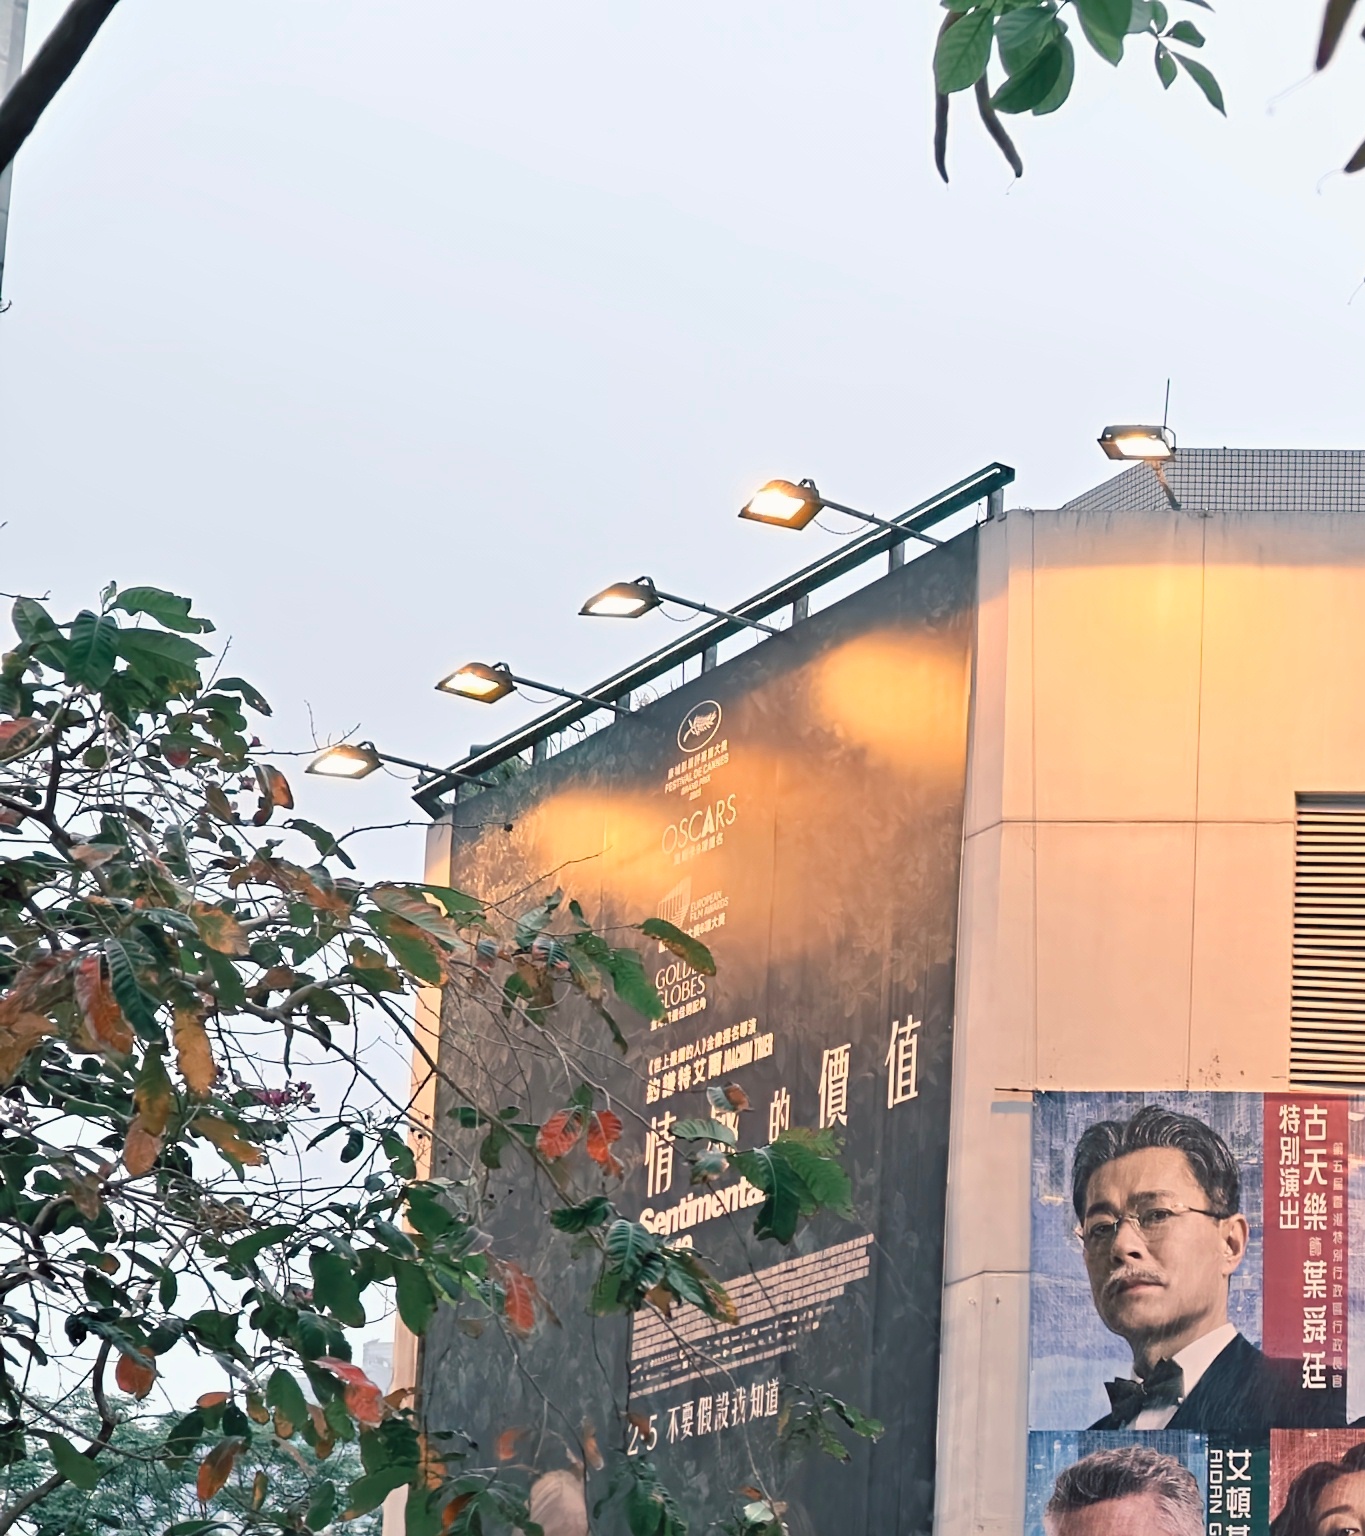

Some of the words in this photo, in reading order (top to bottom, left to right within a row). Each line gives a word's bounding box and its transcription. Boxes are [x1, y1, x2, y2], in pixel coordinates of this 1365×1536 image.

[662, 793, 737, 854] OSCARS
[1278, 1103, 1301, 1231] 特別演出
[666, 1377, 780, 1445] 不要假設我知道
[1209, 1448, 1223, 1515] AIDAN
